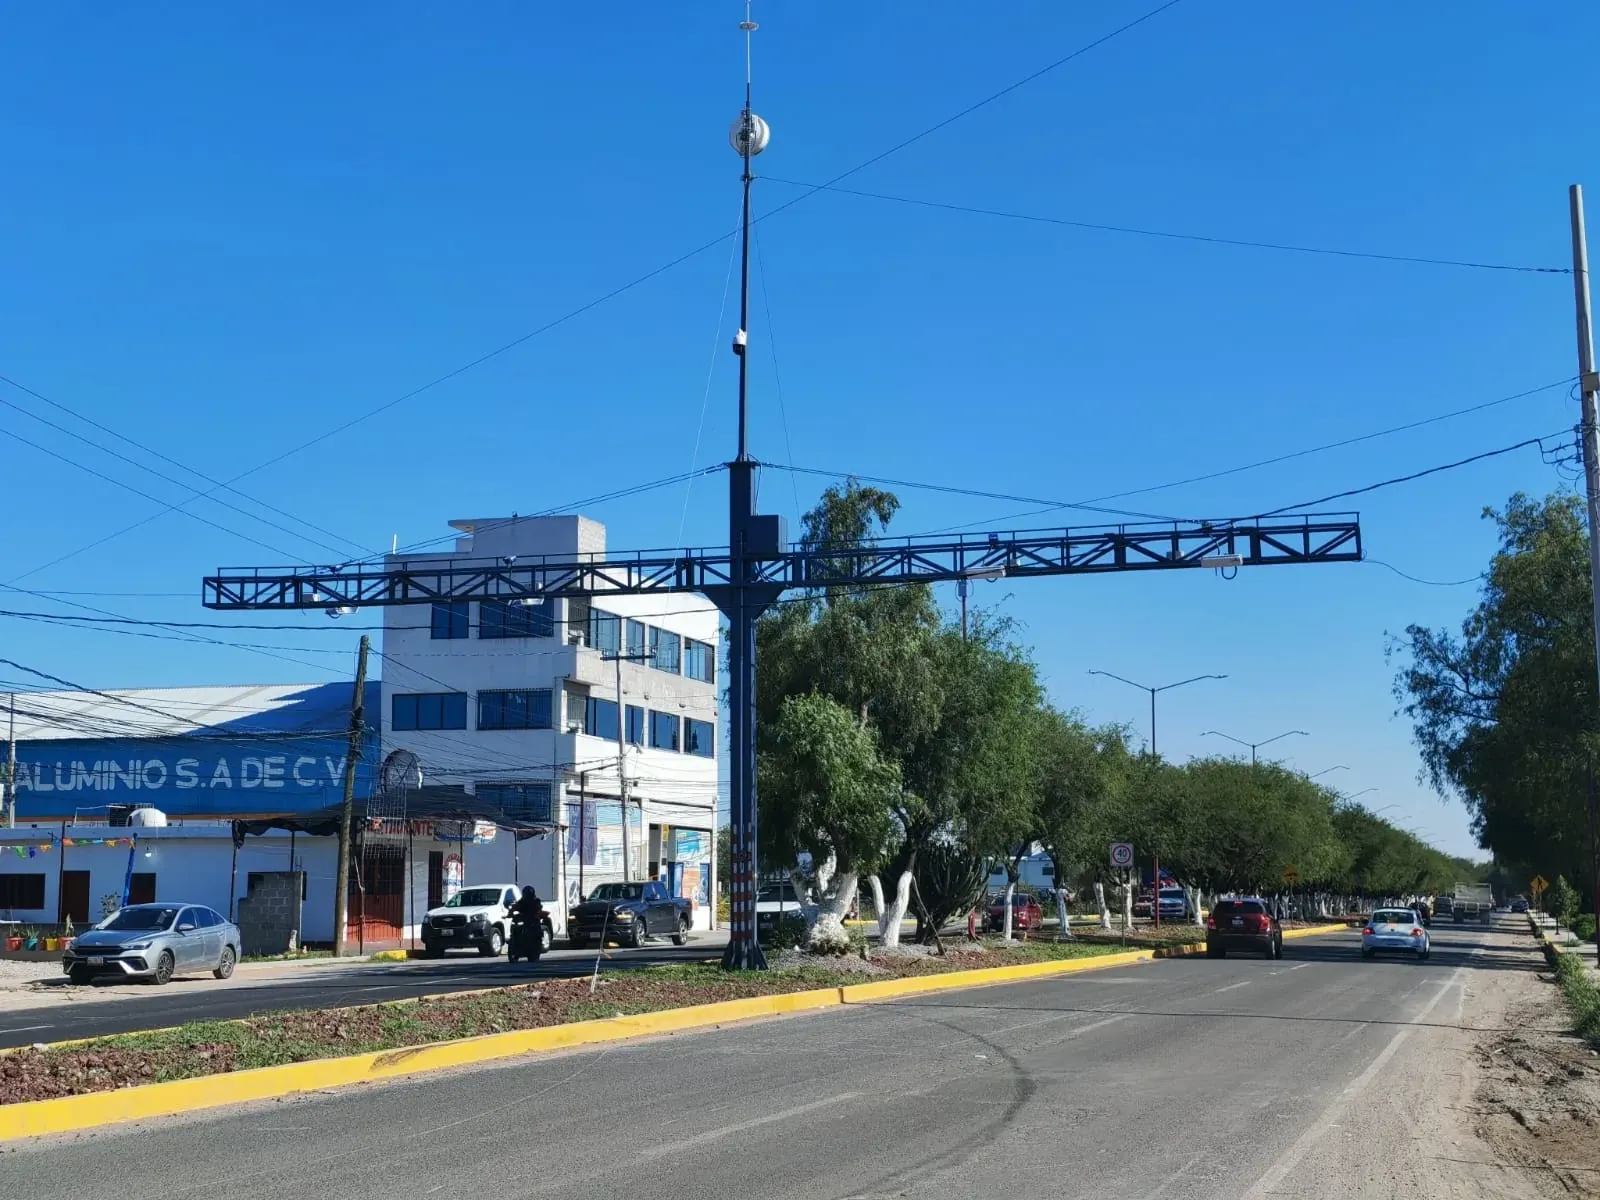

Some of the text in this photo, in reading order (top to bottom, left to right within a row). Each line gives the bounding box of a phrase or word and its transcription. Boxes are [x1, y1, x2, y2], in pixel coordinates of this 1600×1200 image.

[15, 759, 167, 791] ALUMINIO
[241, 757, 286, 788] DE
[1117, 848, 1128, 857] 40
